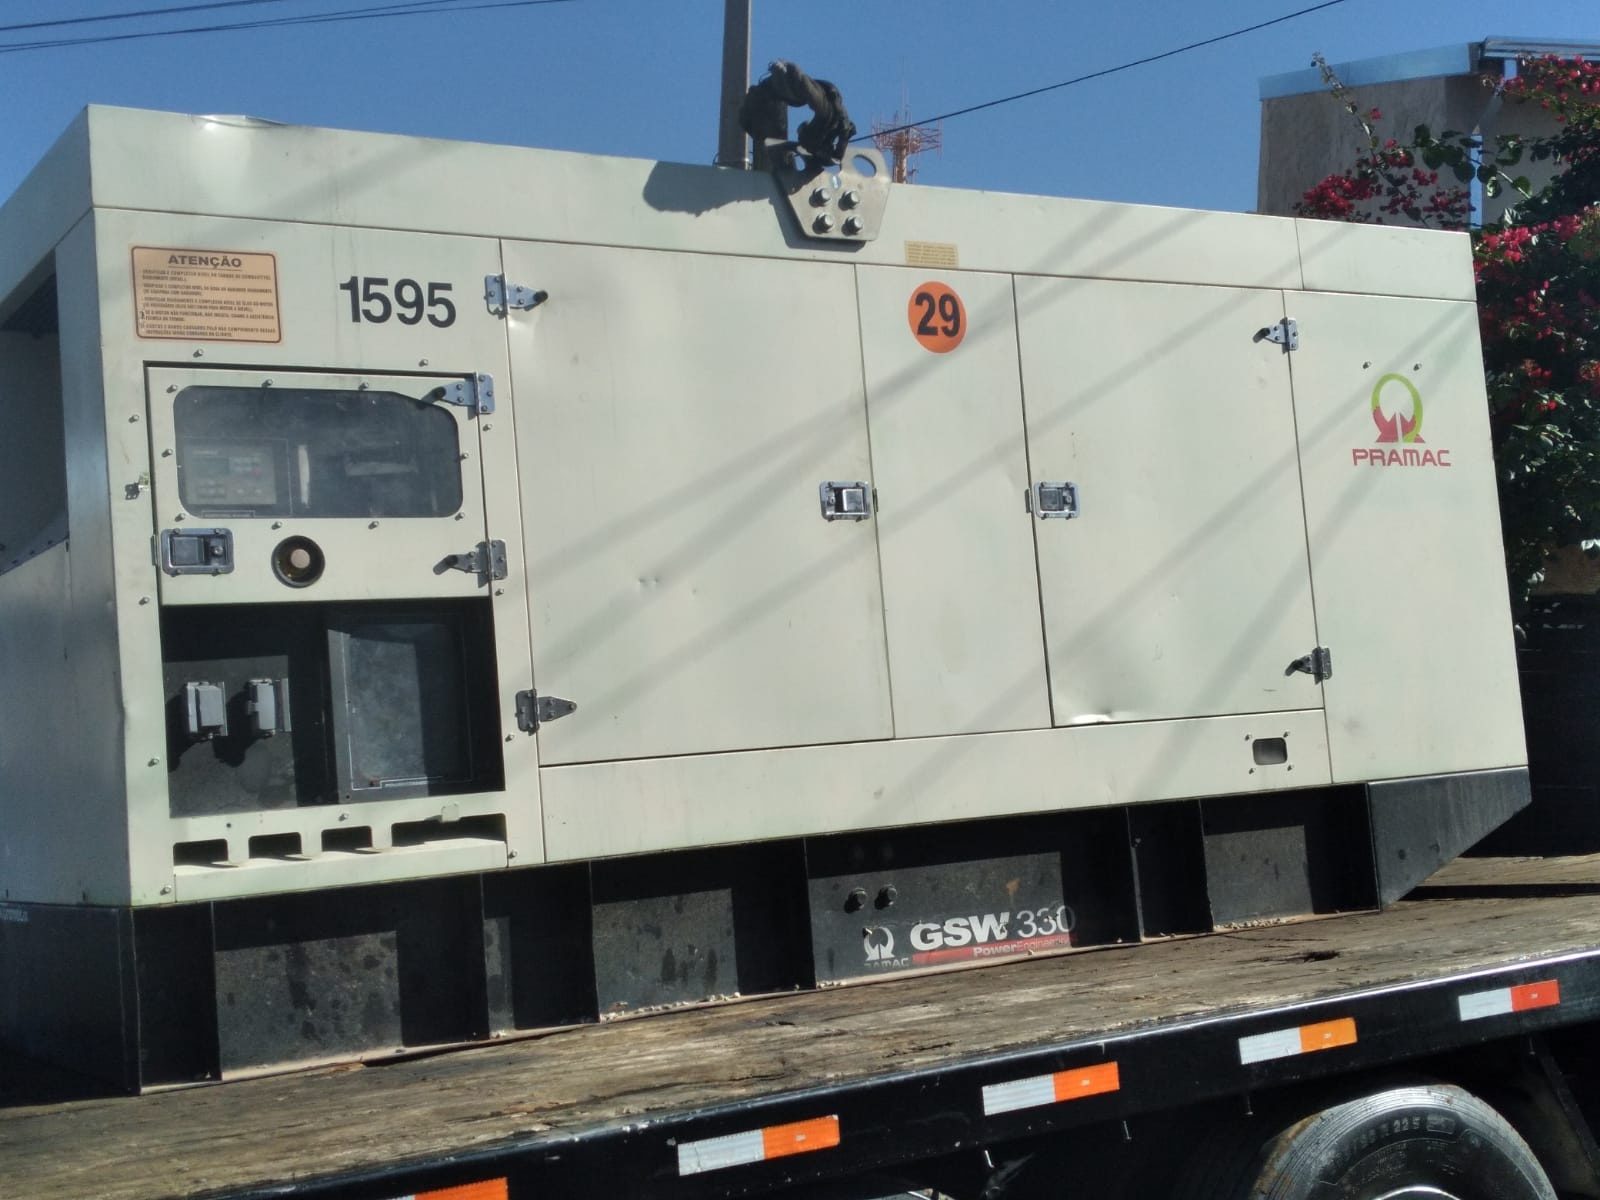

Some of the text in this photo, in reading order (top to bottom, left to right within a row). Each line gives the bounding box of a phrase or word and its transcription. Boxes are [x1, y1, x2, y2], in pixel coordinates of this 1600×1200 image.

[168, 255, 242, 269] ATENÇÃO
[340, 276, 457, 328] 1595
[915, 292, 961, 337] 29
[1352, 448, 1451, 467] PRAMAC
[910, 905, 1075, 951] GSW 330
